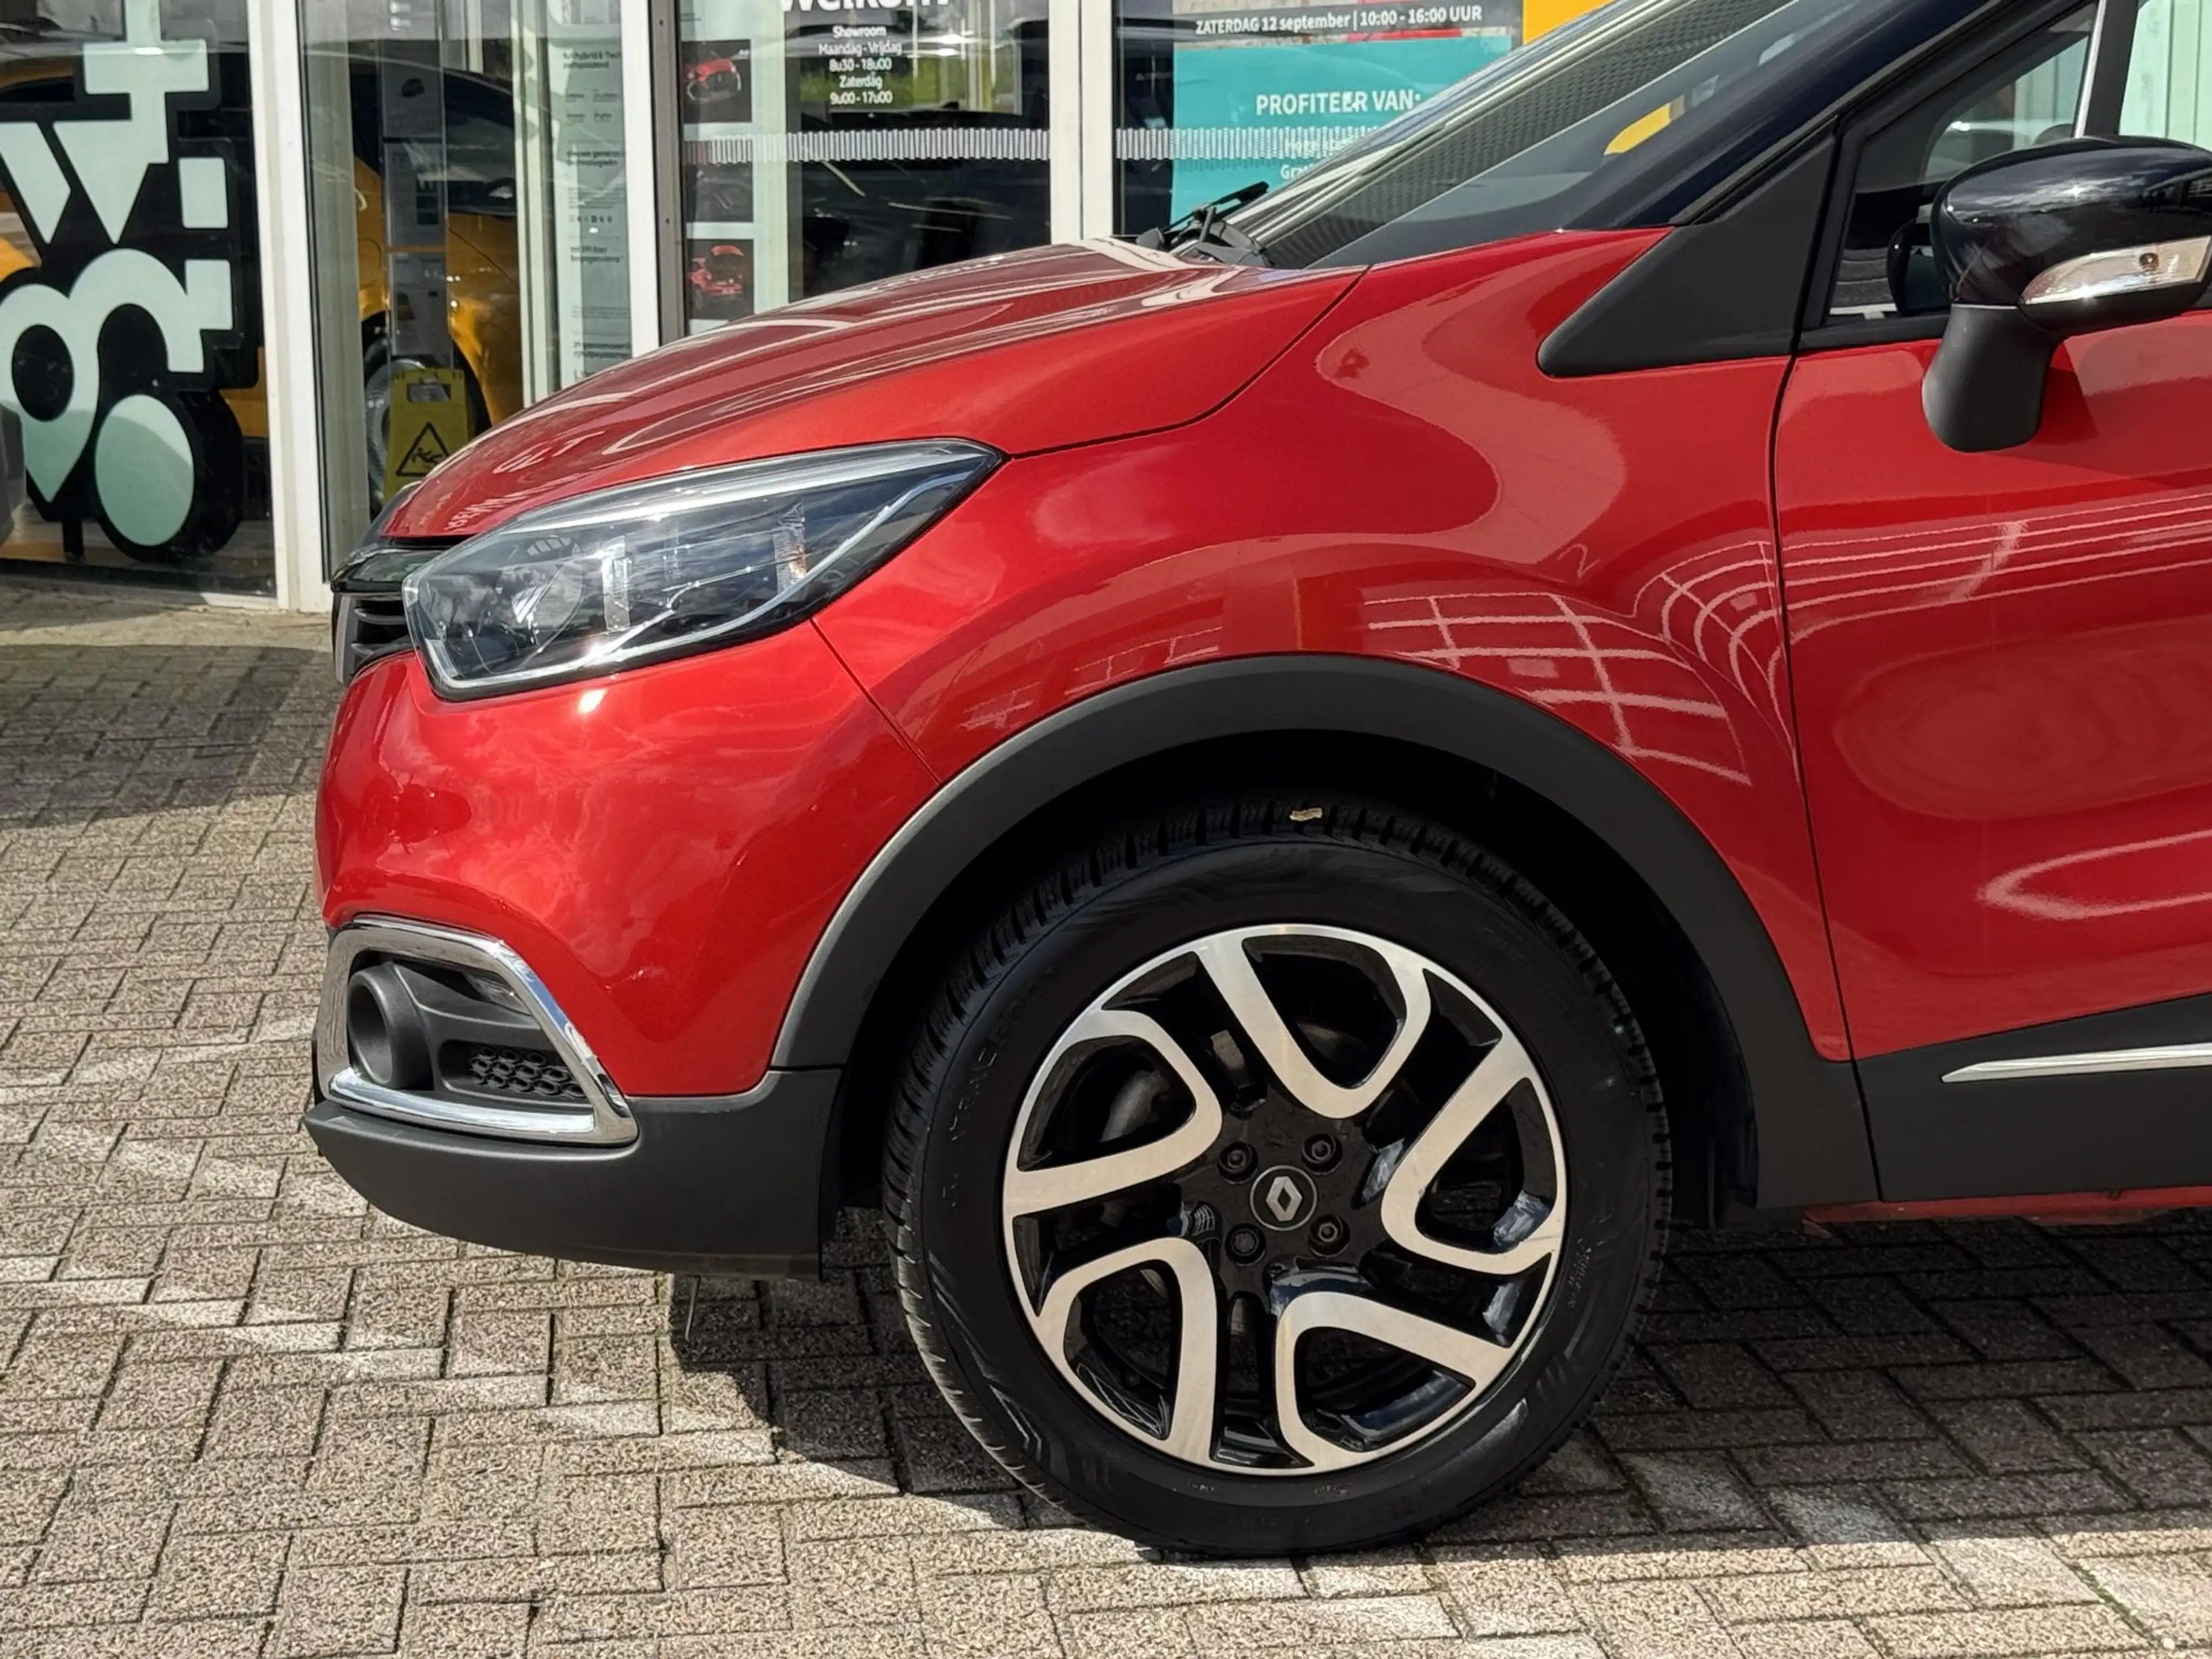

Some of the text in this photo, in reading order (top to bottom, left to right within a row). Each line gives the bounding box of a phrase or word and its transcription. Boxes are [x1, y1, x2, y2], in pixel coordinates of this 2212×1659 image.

[1195, 17, 1259, 35] ZATERDAG
[1262, 16, 1277, 32] 12
[1279, 12, 1351, 33] september
[1359, 10, 1397, 26] 10:00
[1408, 7, 1447, 24] 16:00
[1449, 5, 1483, 22] UUR
[832, 25, 887, 38] Showroom
[818, 43, 862, 56] Maandag
[868, 40, 903, 55] Vrijdag
[829, 59, 854, 72] 8u30
[862, 58, 892, 71] 18u00
[839, 73, 883, 89] Zaterdag
[830, 92, 855, 105] 9u00
[862, 90, 893, 104] 17u00
[1255, 90, 1368, 116] PROFITEER
